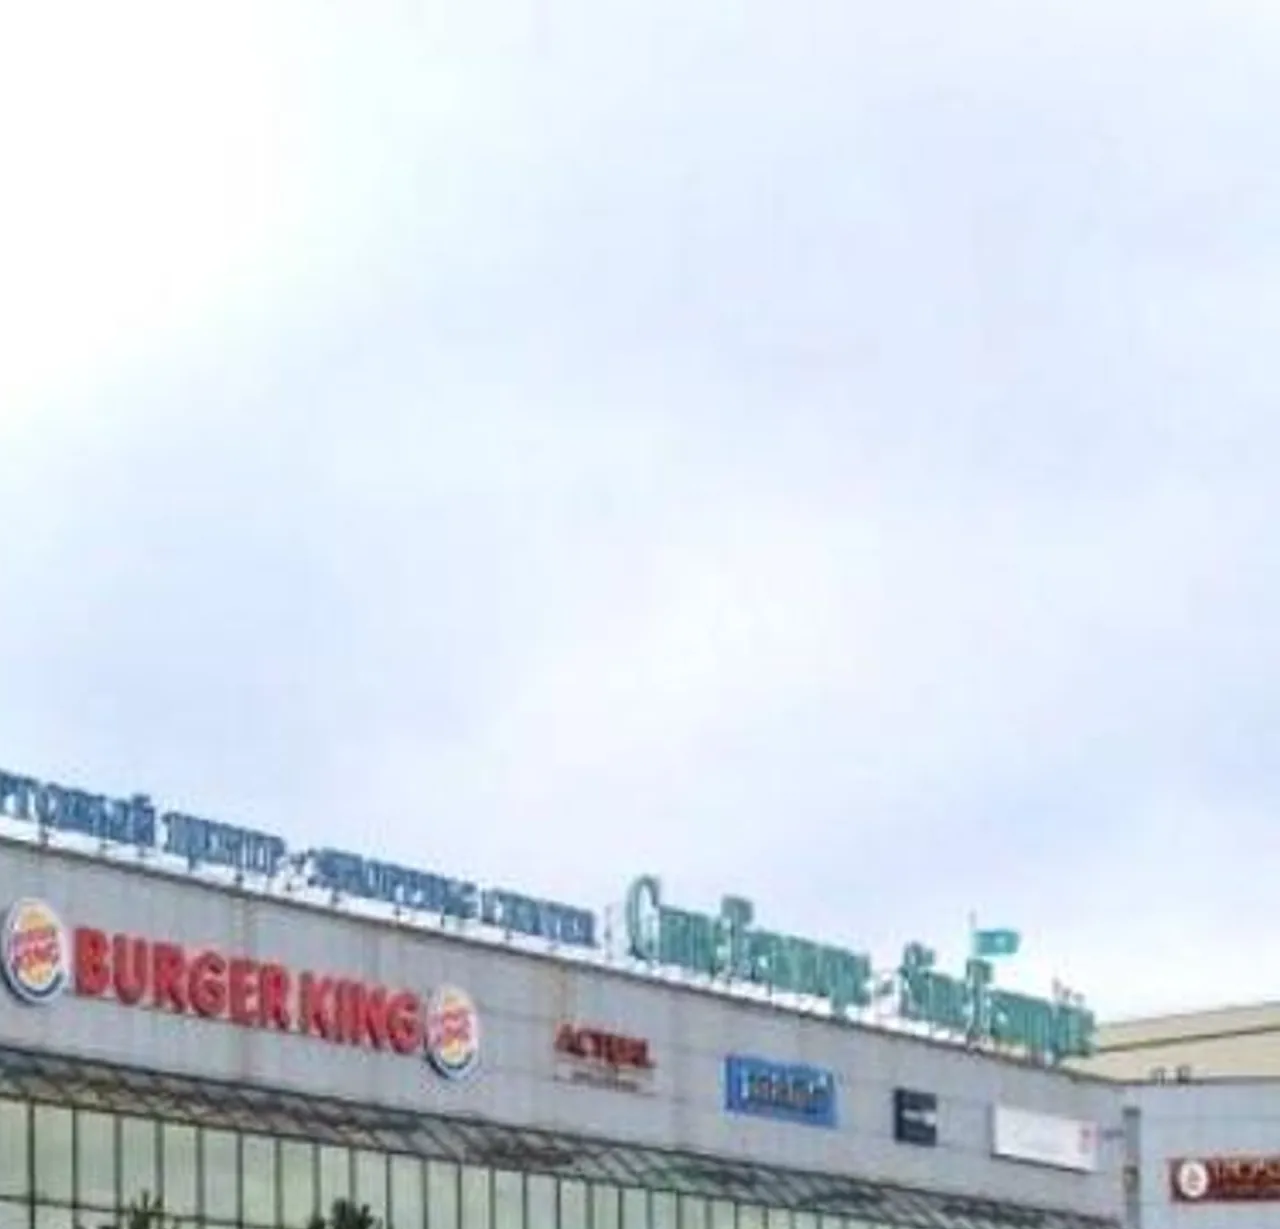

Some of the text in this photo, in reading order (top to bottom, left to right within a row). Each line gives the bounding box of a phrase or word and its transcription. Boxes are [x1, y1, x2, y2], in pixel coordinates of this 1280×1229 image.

[164, 811, 286, 877] ЦЕНТР
[74, 927, 290, 1030] BURGER
[300, 970, 424, 1055] KING
